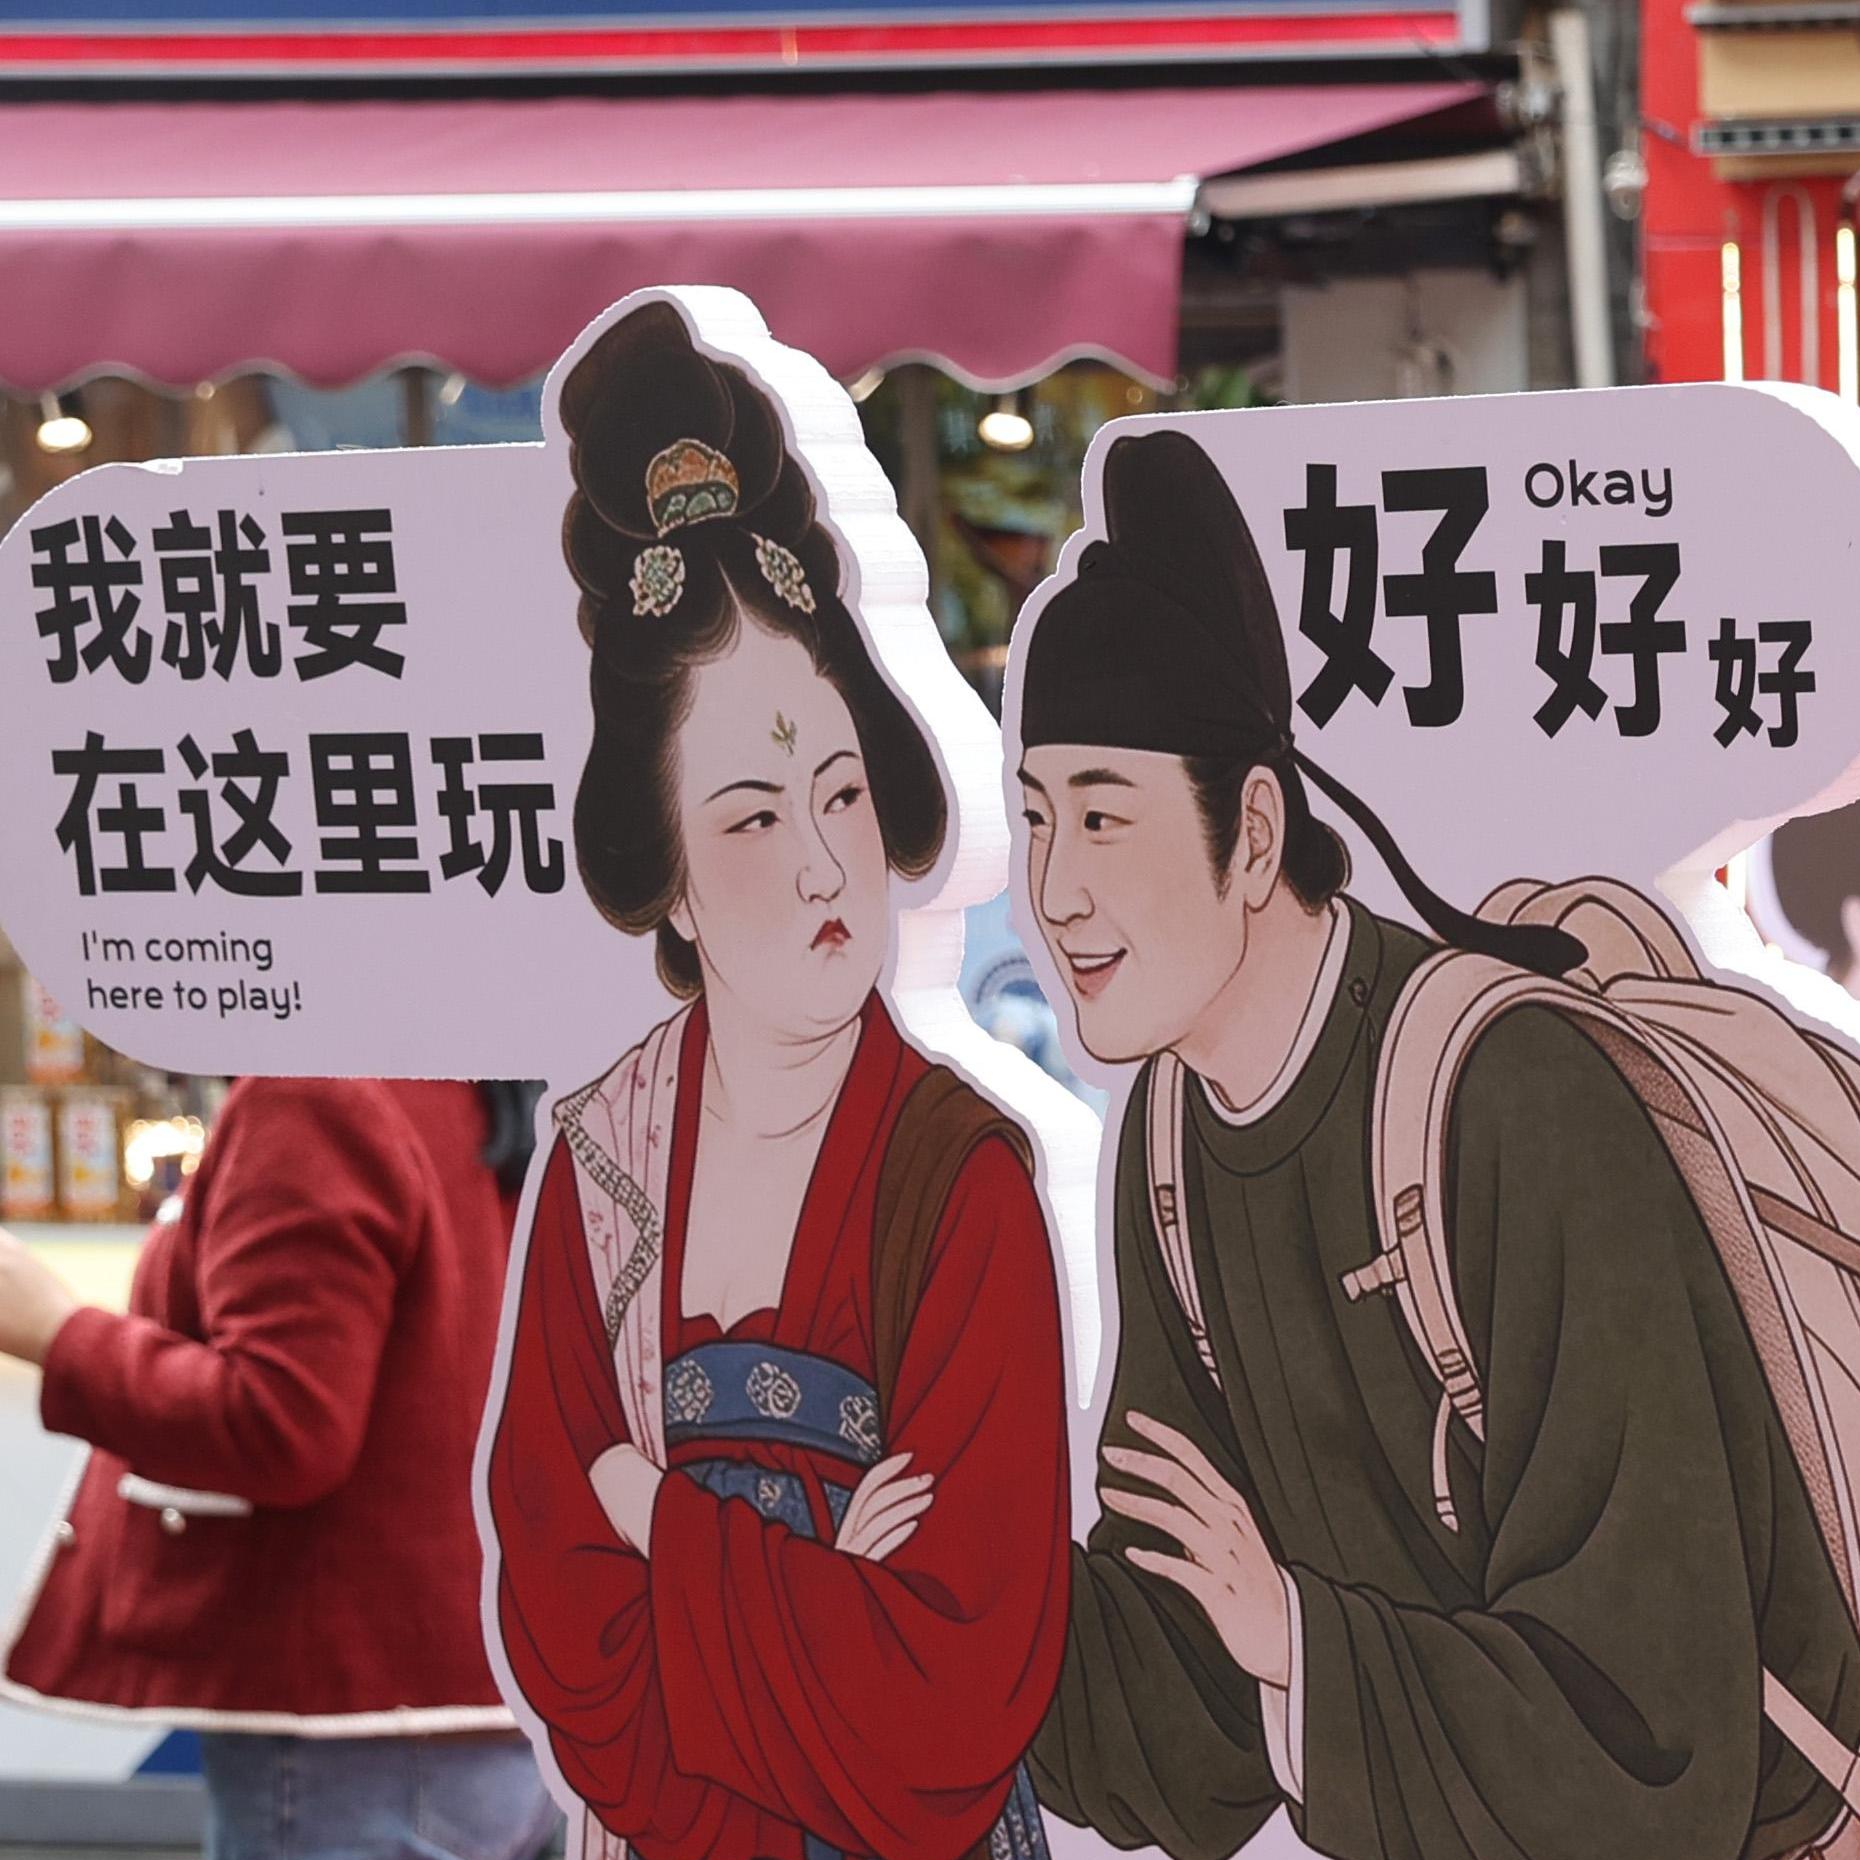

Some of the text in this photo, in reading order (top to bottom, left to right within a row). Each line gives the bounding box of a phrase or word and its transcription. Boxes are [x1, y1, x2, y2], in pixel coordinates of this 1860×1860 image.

[1523, 458, 1674, 517] Okay
[30, 508, 408, 686] 我就要
[50, 727, 566, 898] 在这里玩
[81, 930, 273, 971] I'm coming
[86, 978, 303, 1020] here to play!
